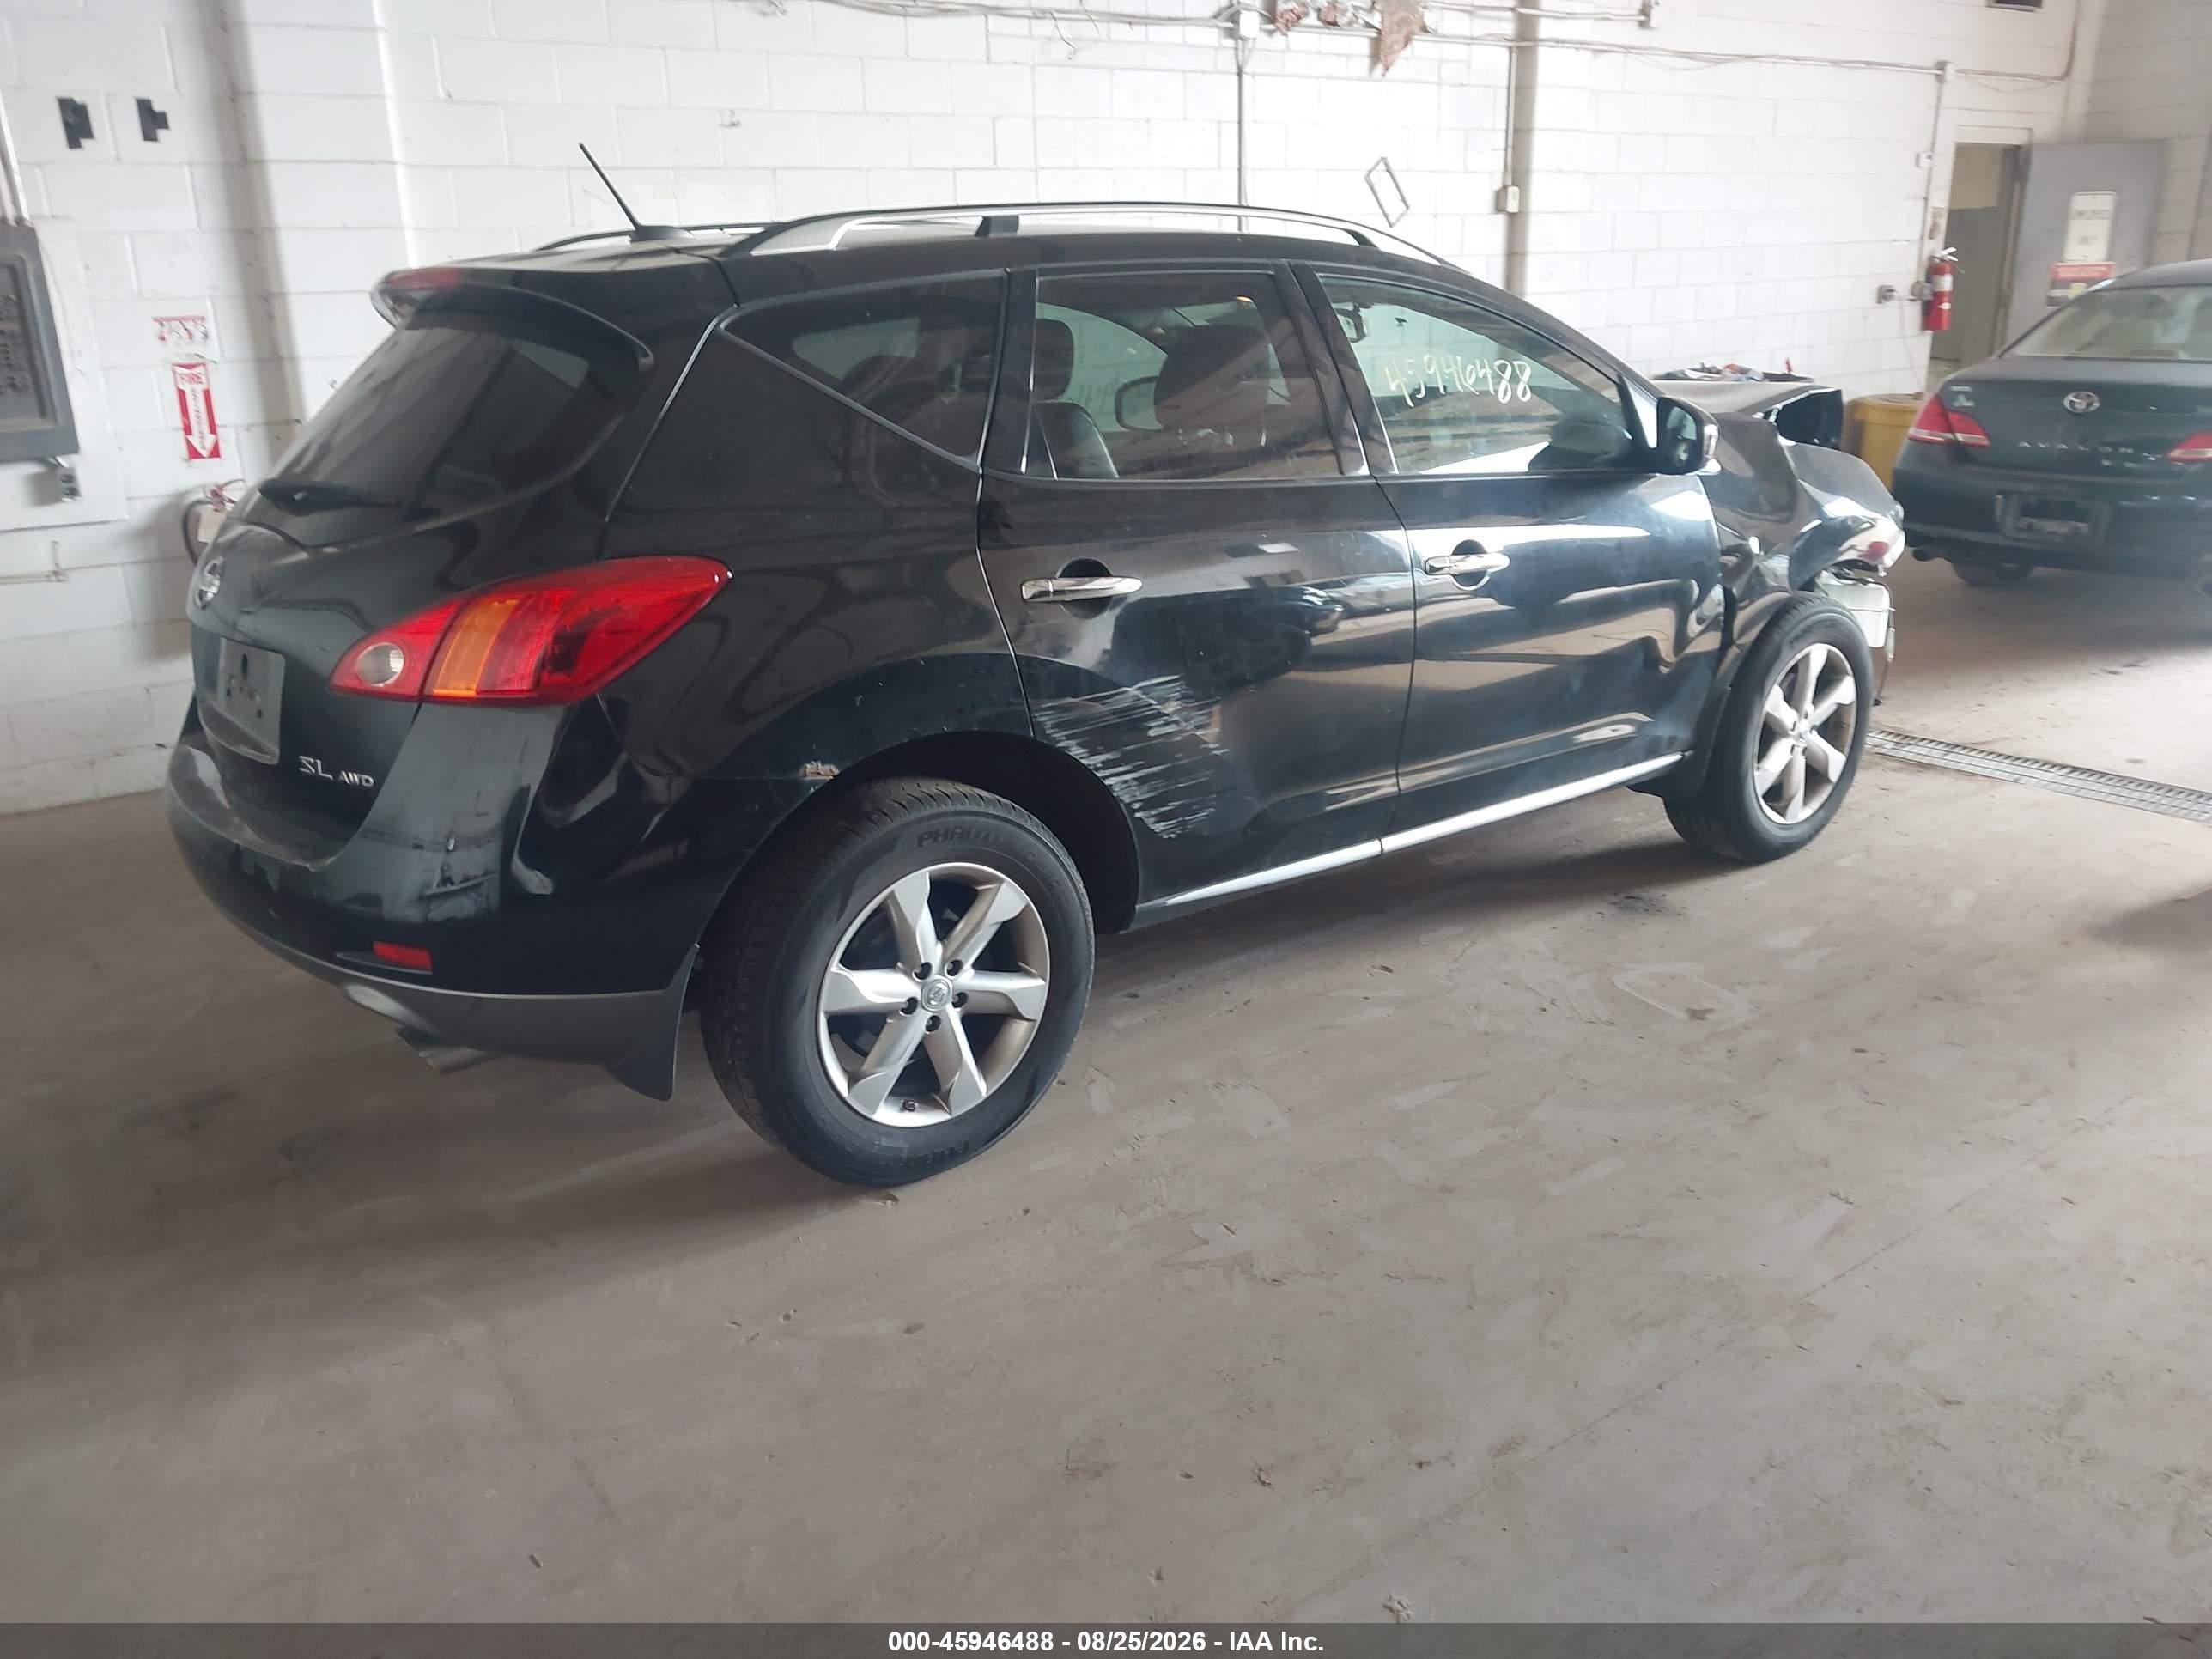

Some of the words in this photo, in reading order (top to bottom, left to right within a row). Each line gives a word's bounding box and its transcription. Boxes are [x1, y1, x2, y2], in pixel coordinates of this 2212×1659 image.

[1384, 354, 1532, 408] 45946488
[2018, 441, 2134, 454] AVALON
[298, 755, 333, 780] SL
[339, 770, 374, 787] AWD
